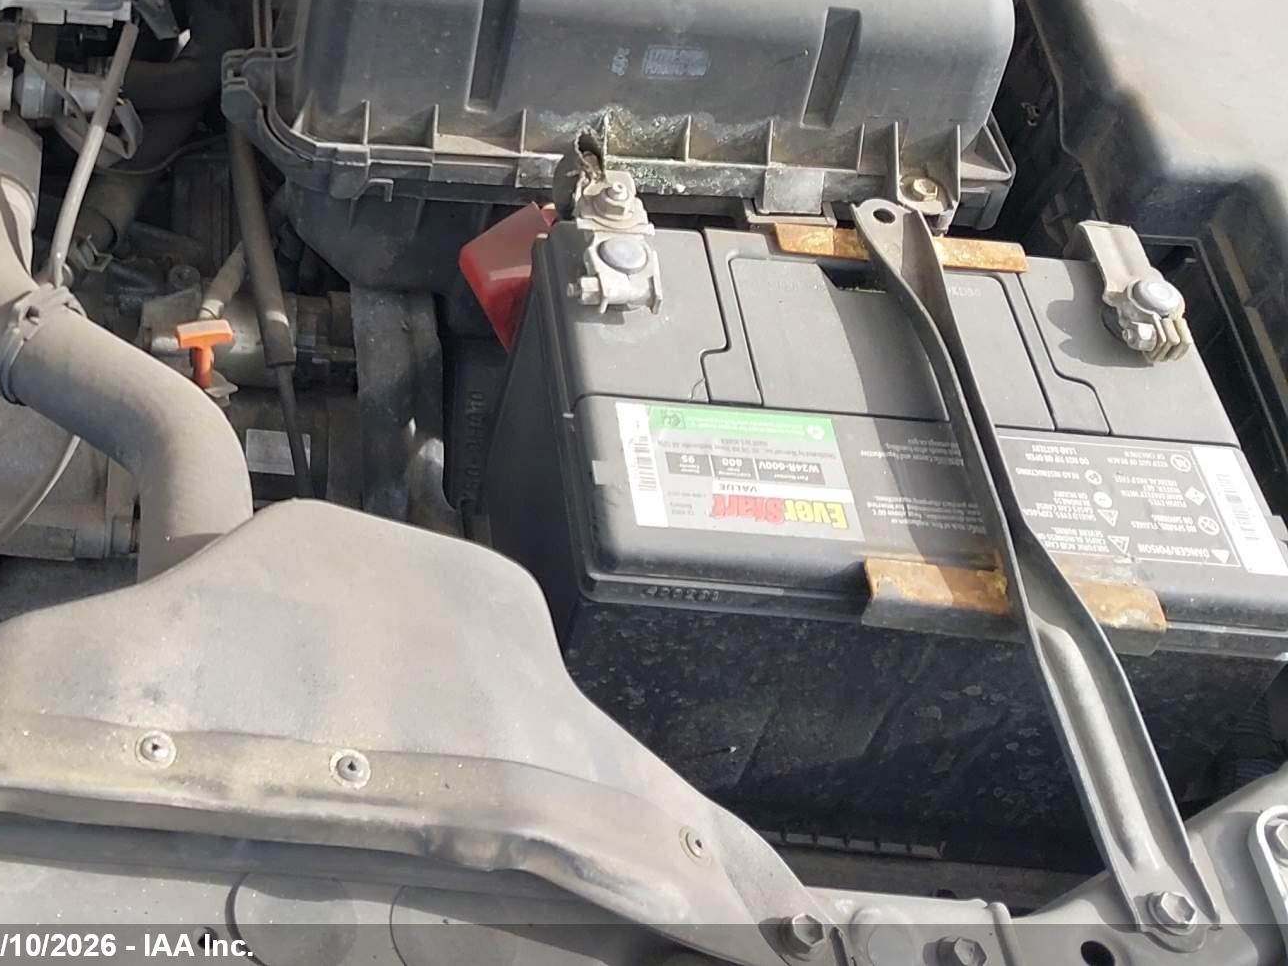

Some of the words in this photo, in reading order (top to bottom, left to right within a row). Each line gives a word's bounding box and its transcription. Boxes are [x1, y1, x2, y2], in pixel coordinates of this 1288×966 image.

[717, 482, 757, 492] VALUE
[712, 494, 848, 529] EverStart
[1136, 544, 1210, 557] DANGER/POISON
